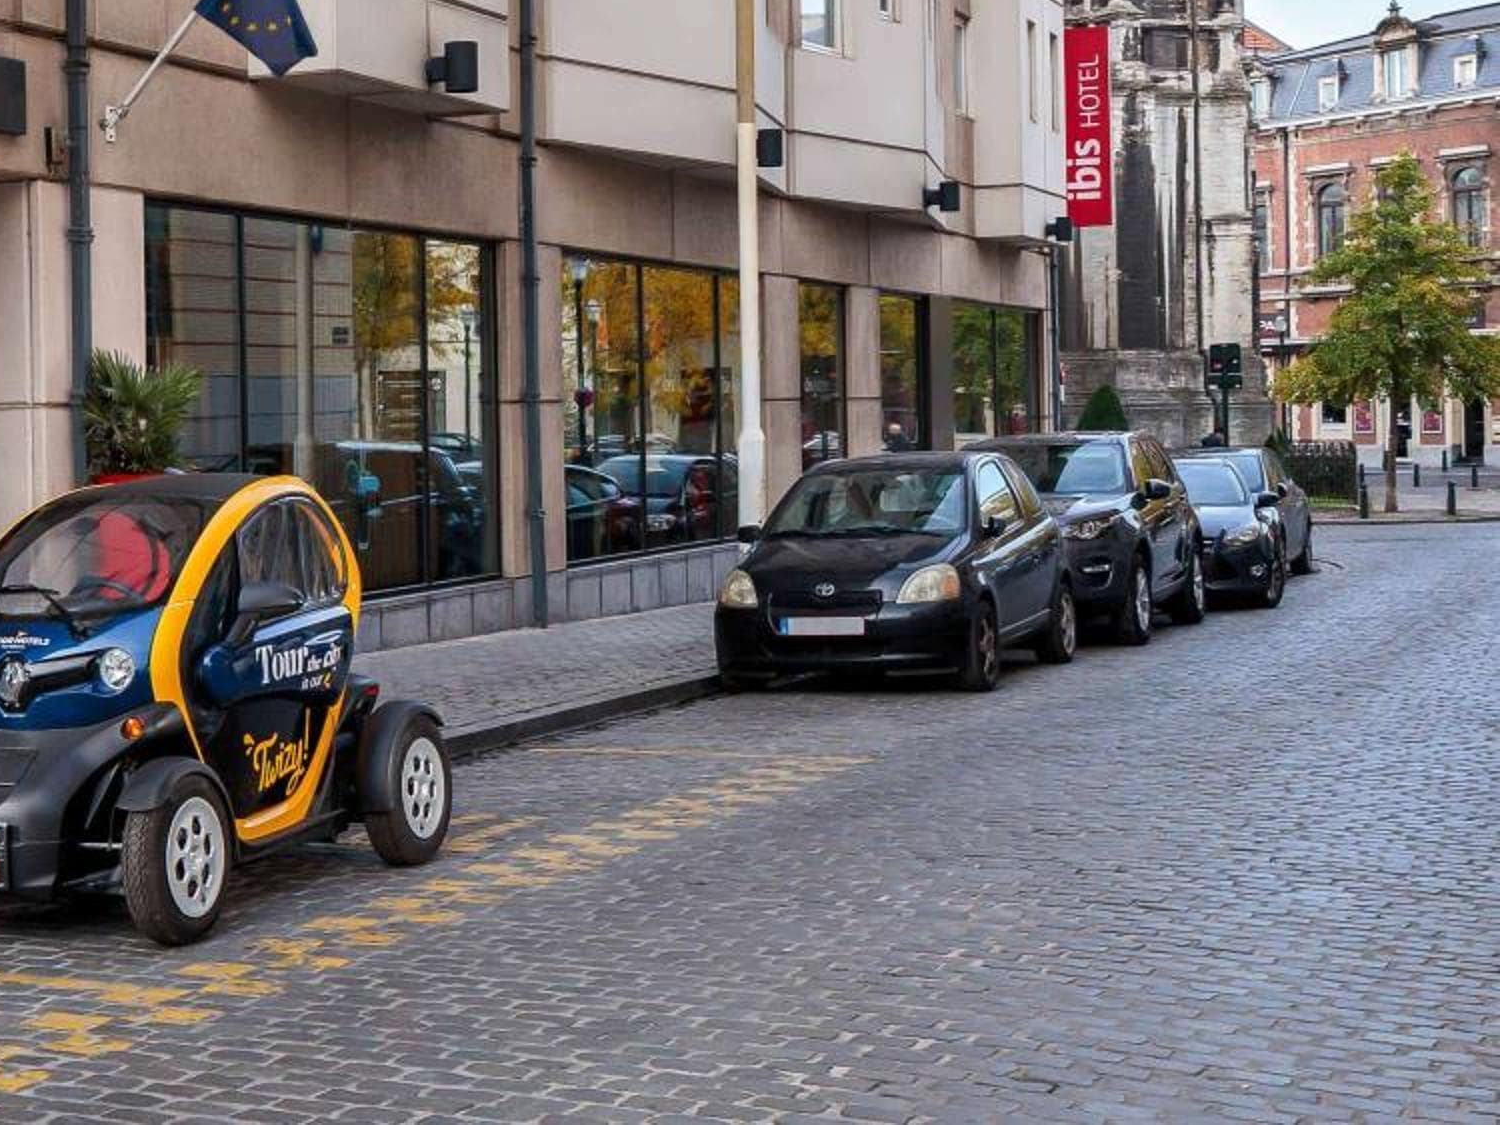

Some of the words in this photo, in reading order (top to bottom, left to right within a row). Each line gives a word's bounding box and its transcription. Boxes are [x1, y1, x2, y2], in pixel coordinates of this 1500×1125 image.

[1077, 54, 1100, 128] HOTEL
[1067, 136, 1102, 201] ibis
[255, 643, 309, 684] Tour
